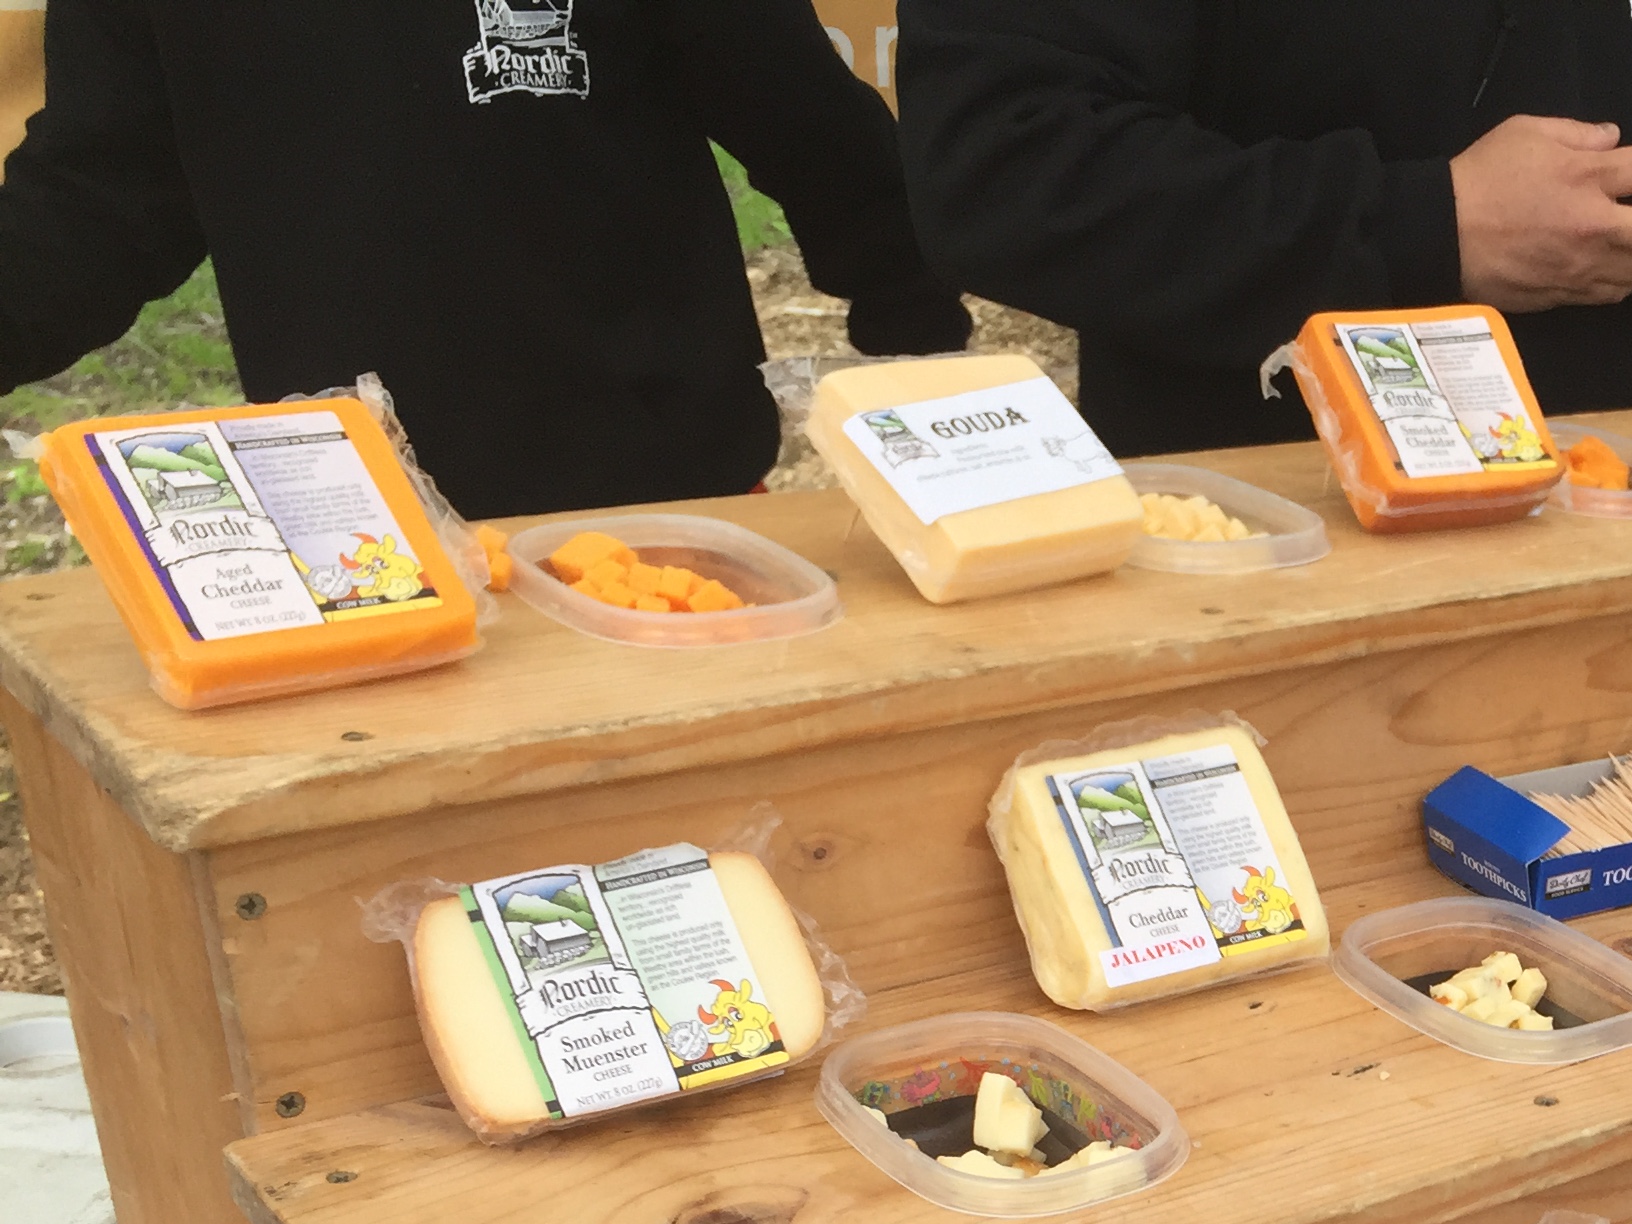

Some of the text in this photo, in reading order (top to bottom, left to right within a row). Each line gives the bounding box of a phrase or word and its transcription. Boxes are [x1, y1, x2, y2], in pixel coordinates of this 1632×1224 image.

[485, 45, 574, 77] Nordic
[500, 71, 567, 88] CREAMERY
[930, 407, 1030, 438] GOUDA
[169, 515, 257, 546] Nordic
[216, 563, 254, 582] Aged
[201, 577, 284, 600] Cheddar
[229, 595, 272, 610] CHEESE
[1108, 853, 1173, 883] Nordic
[1461, 851, 1527, 902] TOOTHPICKS
[1128, 906, 1189, 929] Cheddar
[1149, 924, 1182, 938] CHEESE
[1111, 935, 1206, 969] JALAPENO
[540, 970, 623, 1010] Nordic
[556, 996, 613, 1017] CREAMERY
[560, 1020, 636, 1053] Smoked
[561, 1042, 648, 1075] Muenster
[691, 1055, 735, 1072] COW MILK
[593, 1064, 633, 1082] CHEESE
[576, 1094, 596, 1107] NET
[613, 1086, 621, 1097] 8
